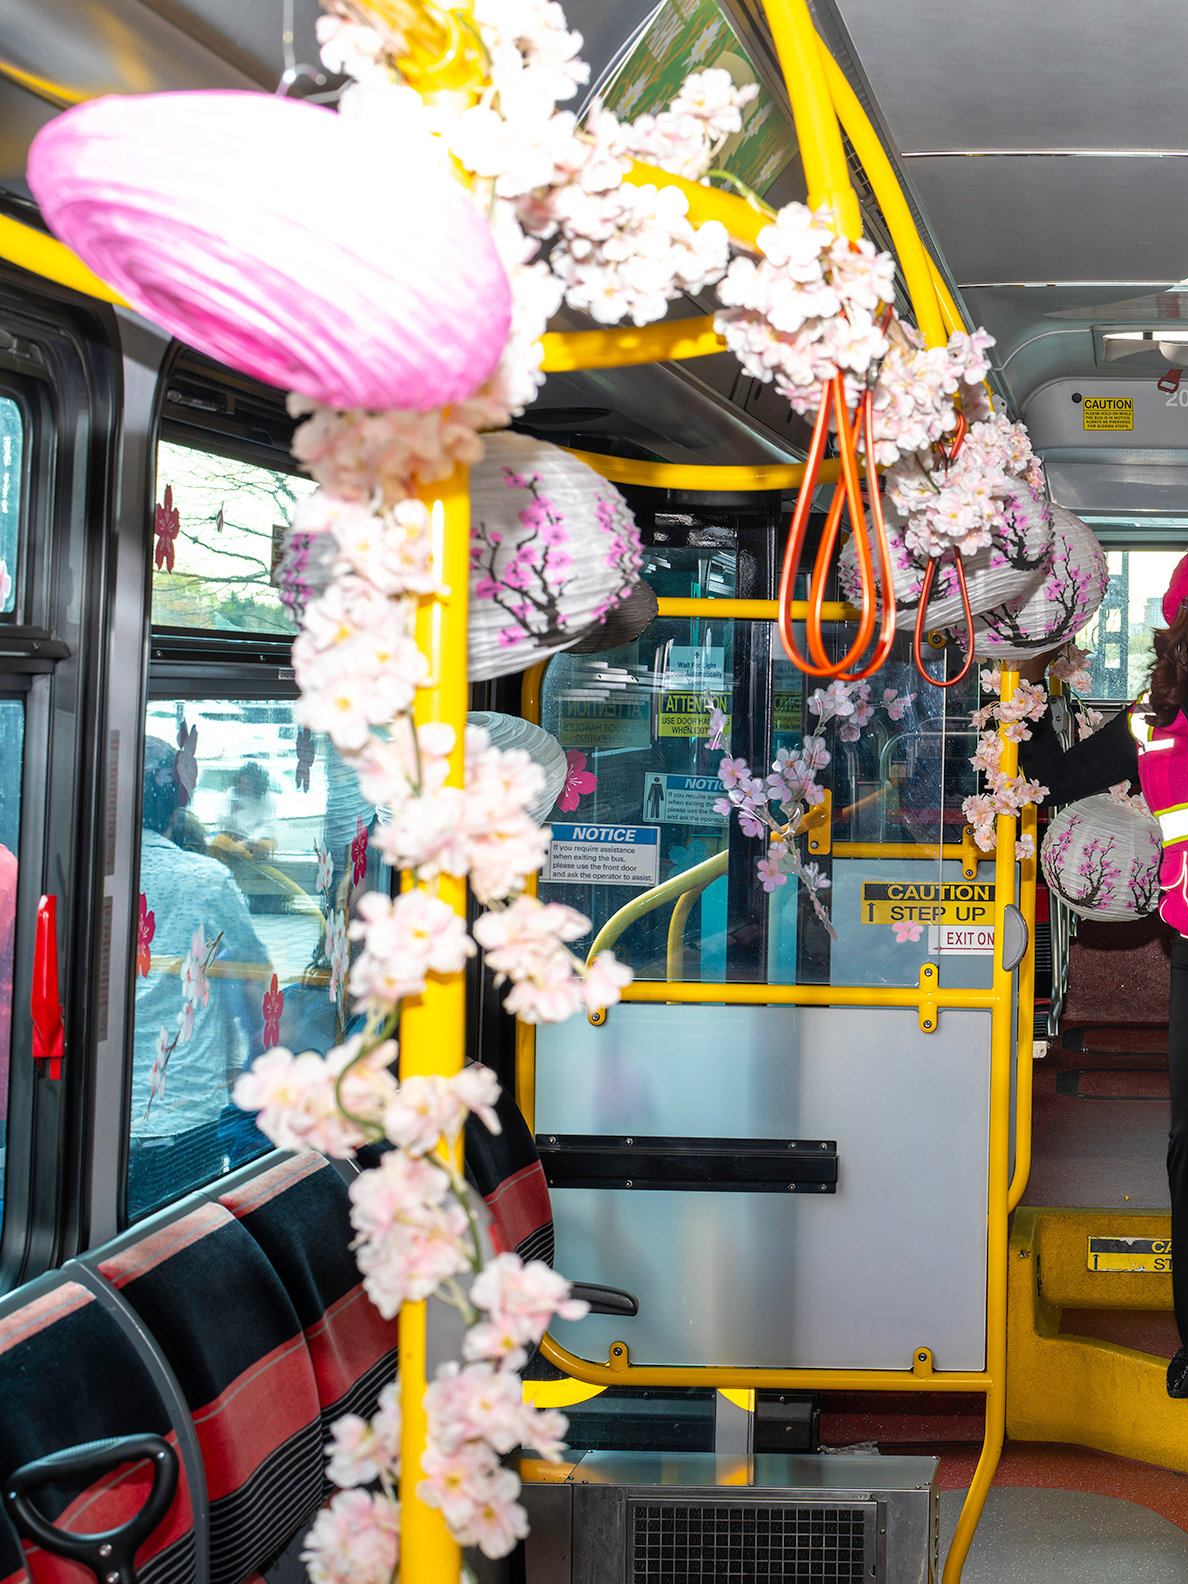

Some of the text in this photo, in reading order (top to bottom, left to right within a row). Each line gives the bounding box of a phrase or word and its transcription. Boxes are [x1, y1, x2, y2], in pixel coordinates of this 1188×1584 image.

[1084, 399, 1132, 409] CAUTION
[666, 695, 727, 713] ATTENTON
[684, 778, 726, 791] NOTIC
[572, 827, 636, 842] NOTICE
[600, 846, 635, 854] assistance
[574, 854, 597, 862] exiting
[621, 864, 637, 872] door
[887, 885, 990, 900] CAUTION
[890, 906, 986, 921] STEP UP
[947, 932, 994, 945] EXIT ON
